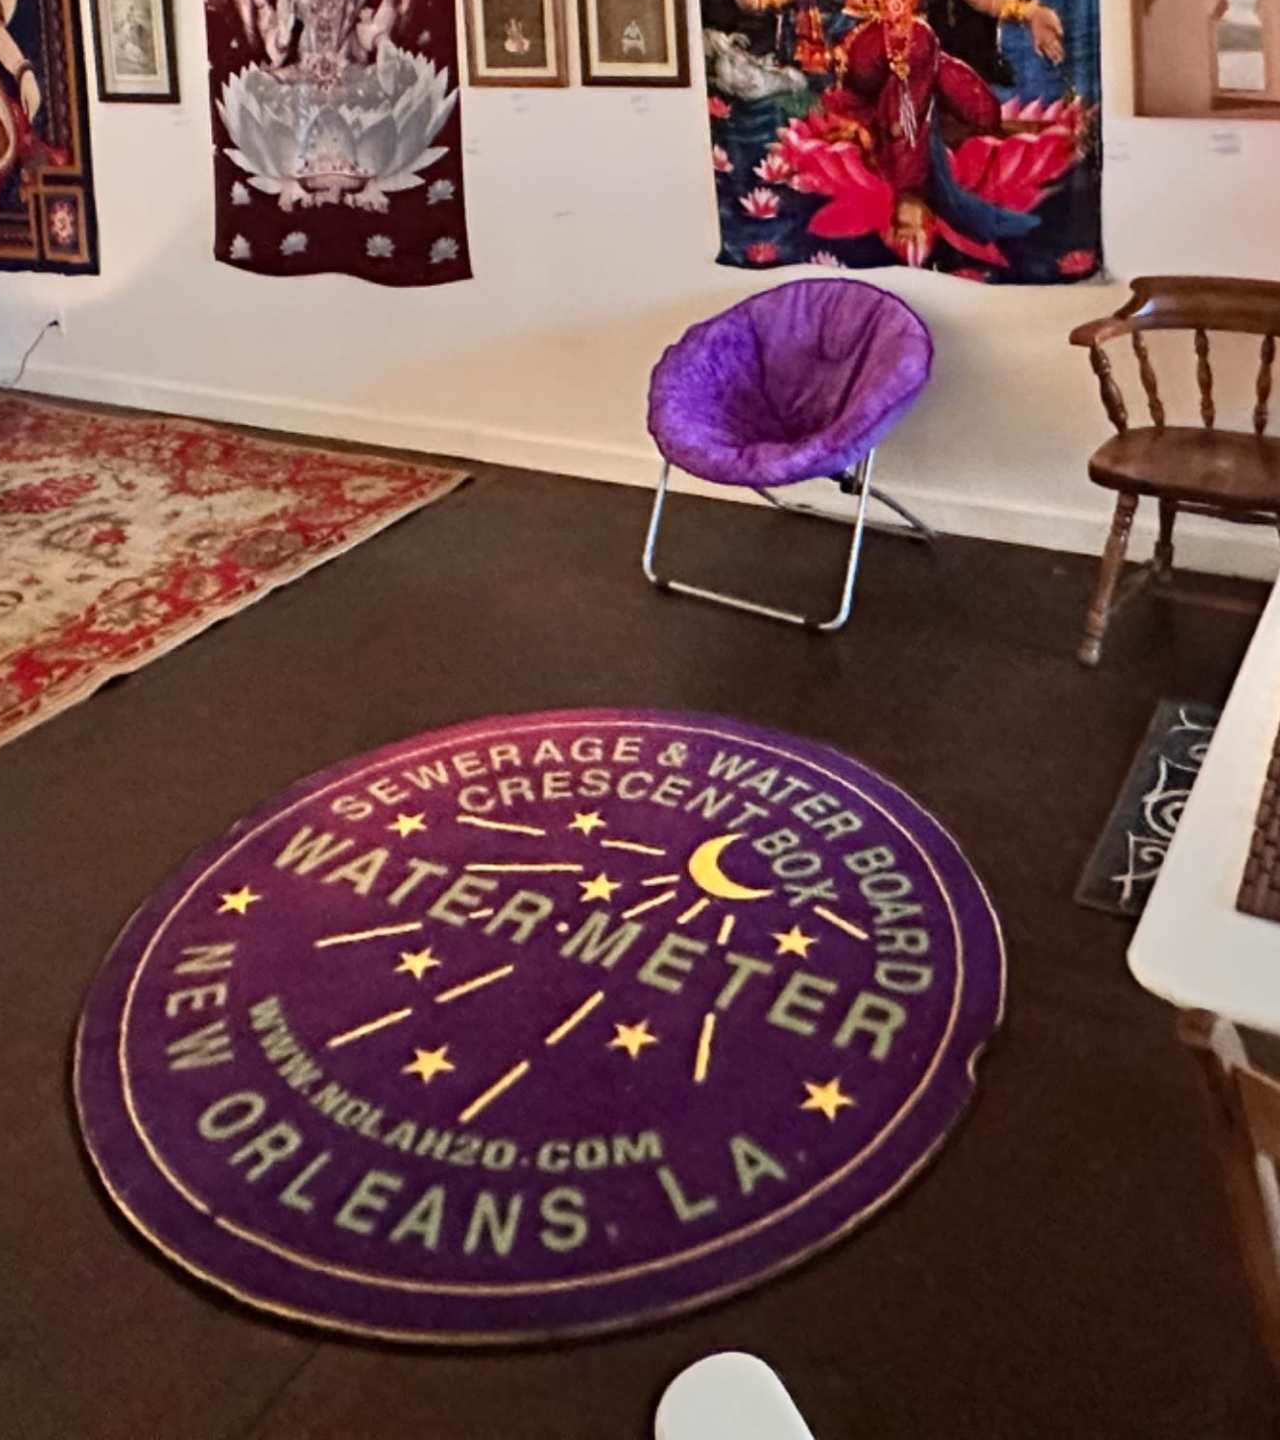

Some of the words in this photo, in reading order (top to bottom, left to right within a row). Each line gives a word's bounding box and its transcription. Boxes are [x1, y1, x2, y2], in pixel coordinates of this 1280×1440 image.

[330, 736, 642, 820] SEWERAGE
[657, 741, 688, 766] &
[708, 751, 862, 841] WATER
[844, 846, 933, 992] BOARD
[457, 768, 768, 829] CRESCENT
[752, 828, 838, 907] BOX
[166, 942, 237, 1070] NEW
[274, 825, 554, 943] WATER
[559, 910, 907, 1060] METER
